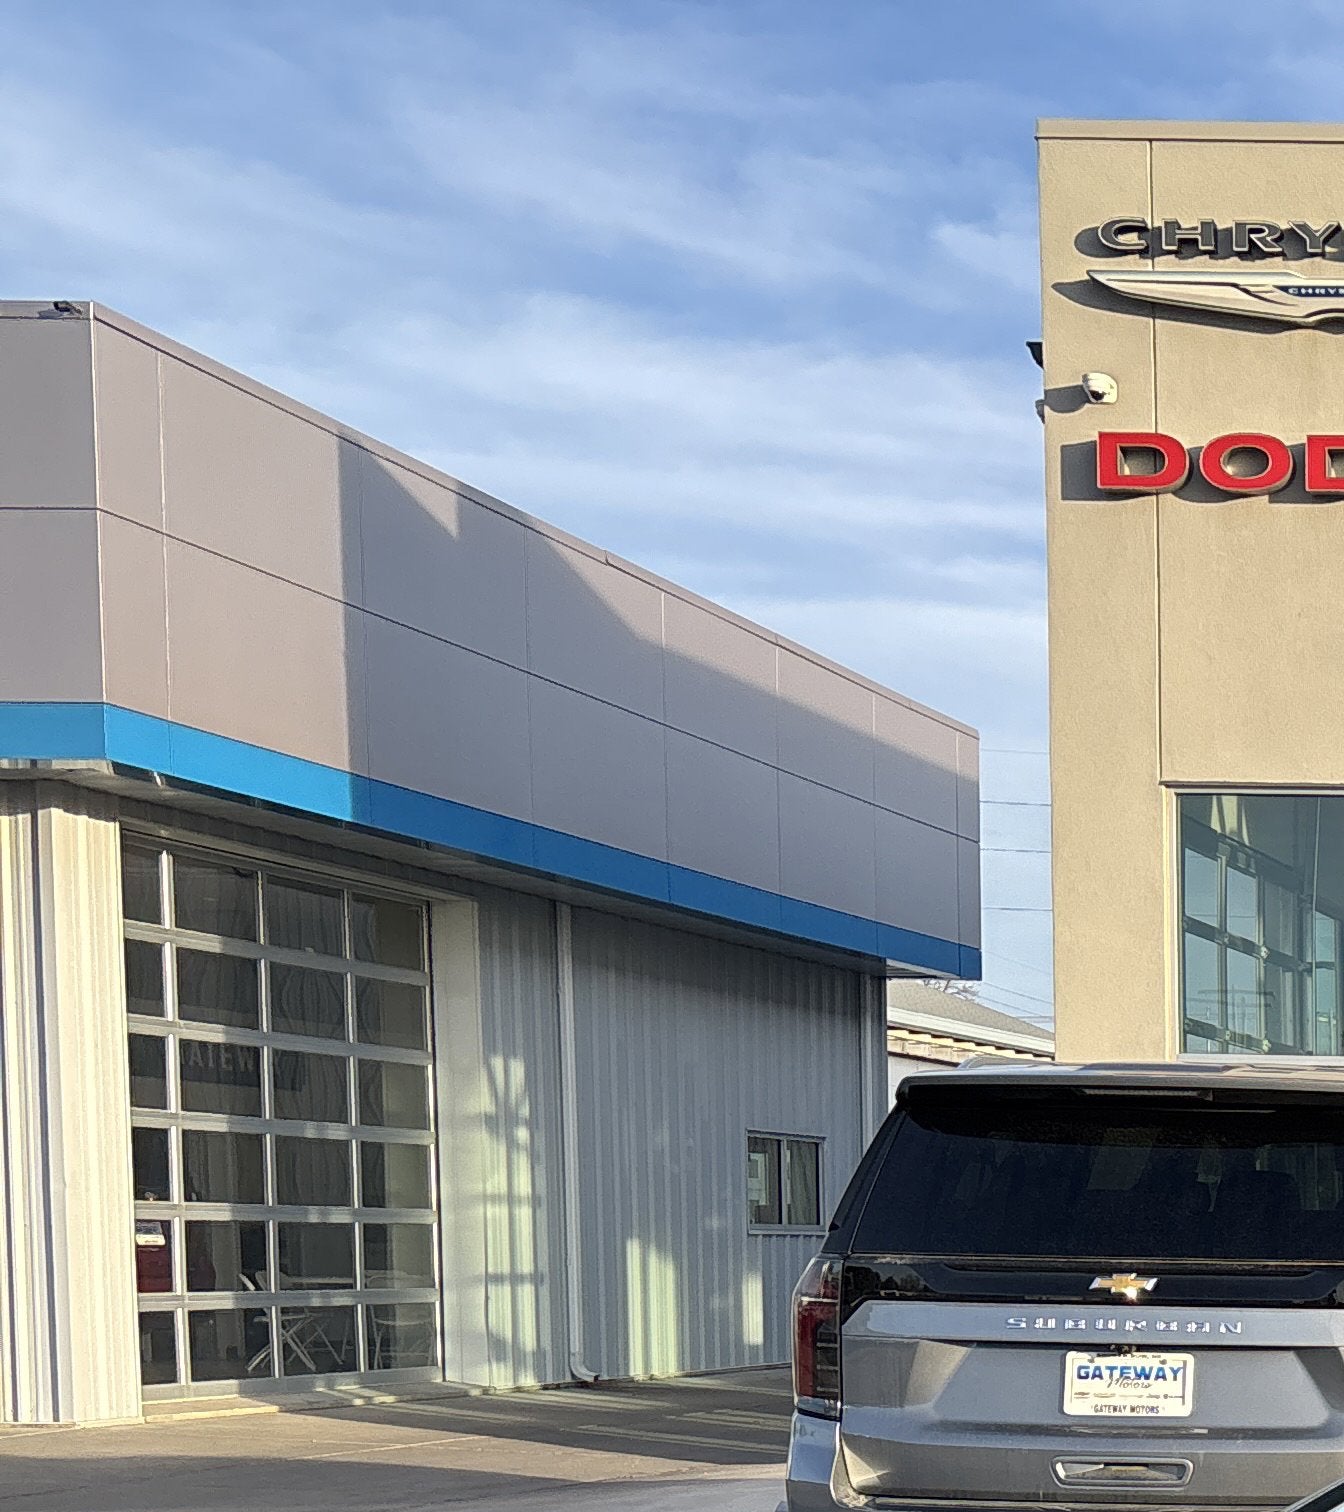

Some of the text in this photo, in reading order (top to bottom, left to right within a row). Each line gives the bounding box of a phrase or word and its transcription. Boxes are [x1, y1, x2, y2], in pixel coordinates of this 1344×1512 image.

[1005, 1317, 1243, 1335] SUBURBAN
[1076, 1364, 1183, 1382] GATEWAY
[1093, 1403, 1160, 1415] GATEWAY MOTORS
